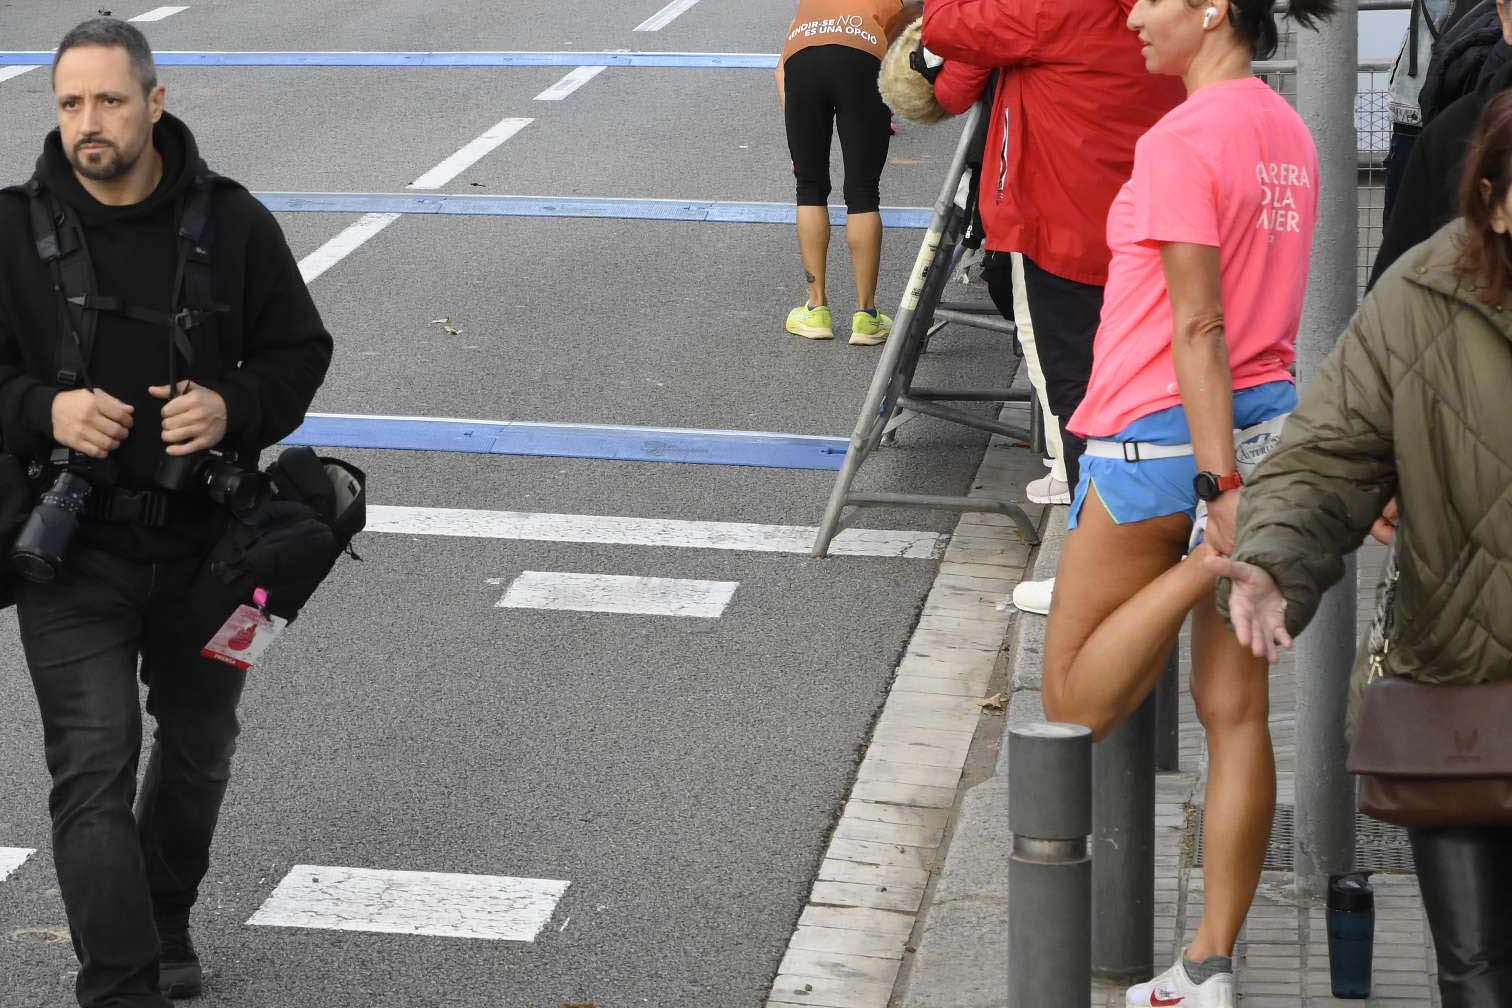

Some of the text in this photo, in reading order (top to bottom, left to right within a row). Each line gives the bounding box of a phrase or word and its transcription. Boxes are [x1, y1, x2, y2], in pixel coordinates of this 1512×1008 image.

[836, 15, 863, 28] NO
[805, 28, 817, 37] ES
[820, 25, 842, 34] UNA
